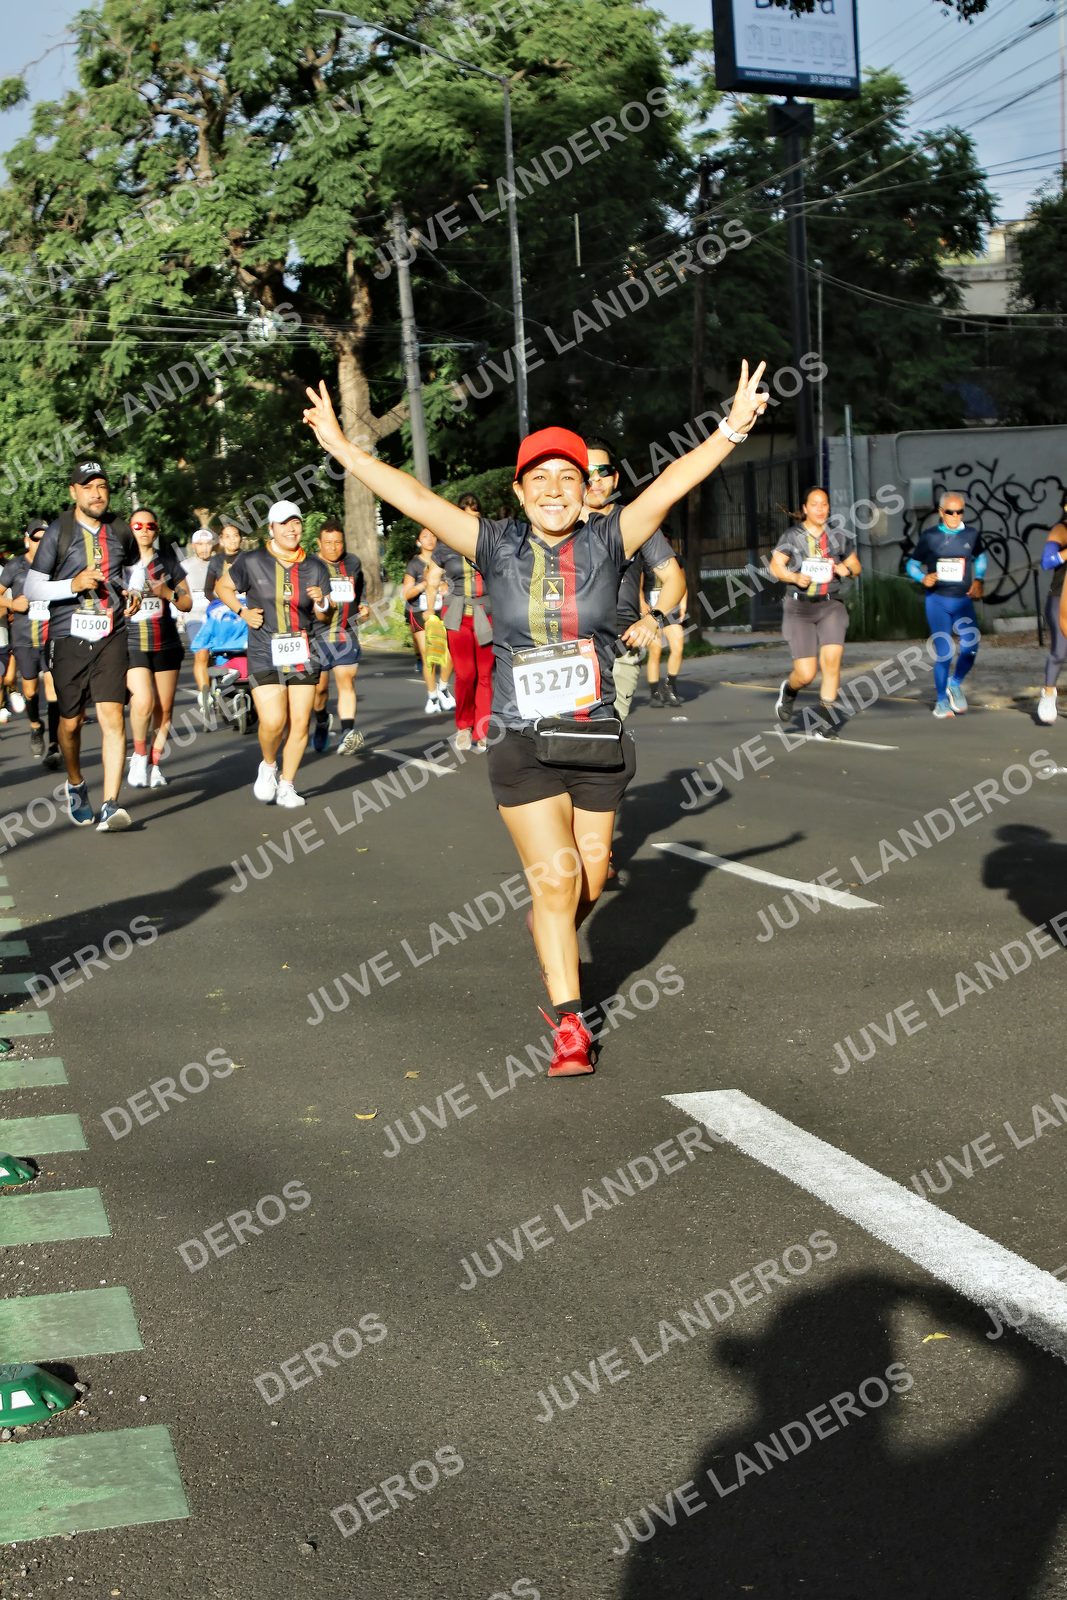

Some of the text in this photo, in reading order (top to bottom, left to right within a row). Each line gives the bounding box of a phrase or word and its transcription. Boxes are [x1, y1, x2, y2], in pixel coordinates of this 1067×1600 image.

[934, 458, 999, 483] TOY
[75, 619, 108, 630] 10500
[278, 641, 301, 653] 9659
[519, 663, 589, 696] 13279
